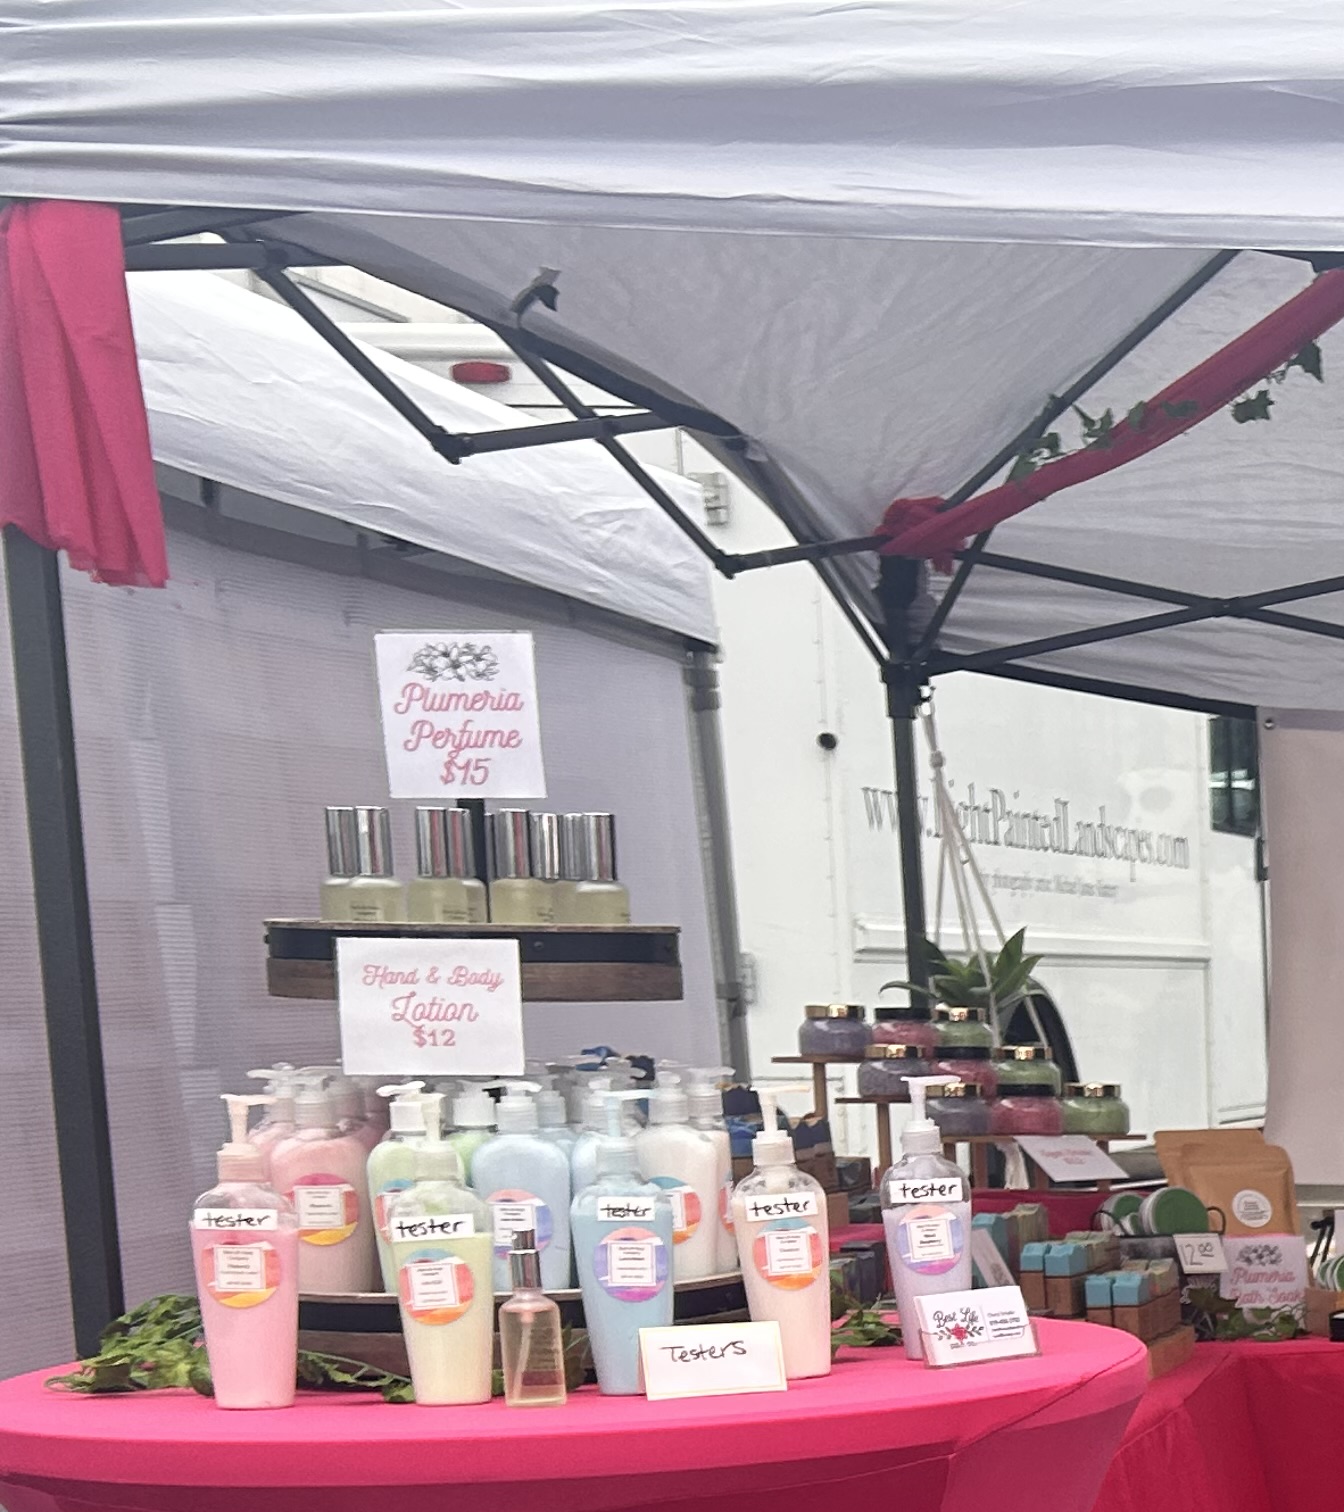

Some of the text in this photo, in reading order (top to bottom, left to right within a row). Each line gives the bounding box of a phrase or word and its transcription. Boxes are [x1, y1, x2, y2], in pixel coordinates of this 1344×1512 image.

[393, 683, 524, 715] Plumeria
[403, 720, 523, 759] Perfume
[440, 757, 492, 787] $15
[362, 964, 505, 992] Hand & Body
[391, 992, 480, 1028] Lotion
[413, 1027, 457, 1048] $12
[900, 1181, 958, 1200] tester
[600, 1203, 652, 1219] tester
[749, 1197, 810, 1217] tester
[201, 1212, 271, 1228] tester
[397, 1219, 465, 1237] tester
[1230, 1267, 1296, 1286] Plumeria
[933, 1310, 957, 1329] Best
[960, 1307, 980, 1326] Life
[661, 1339, 748, 1364] Testers
